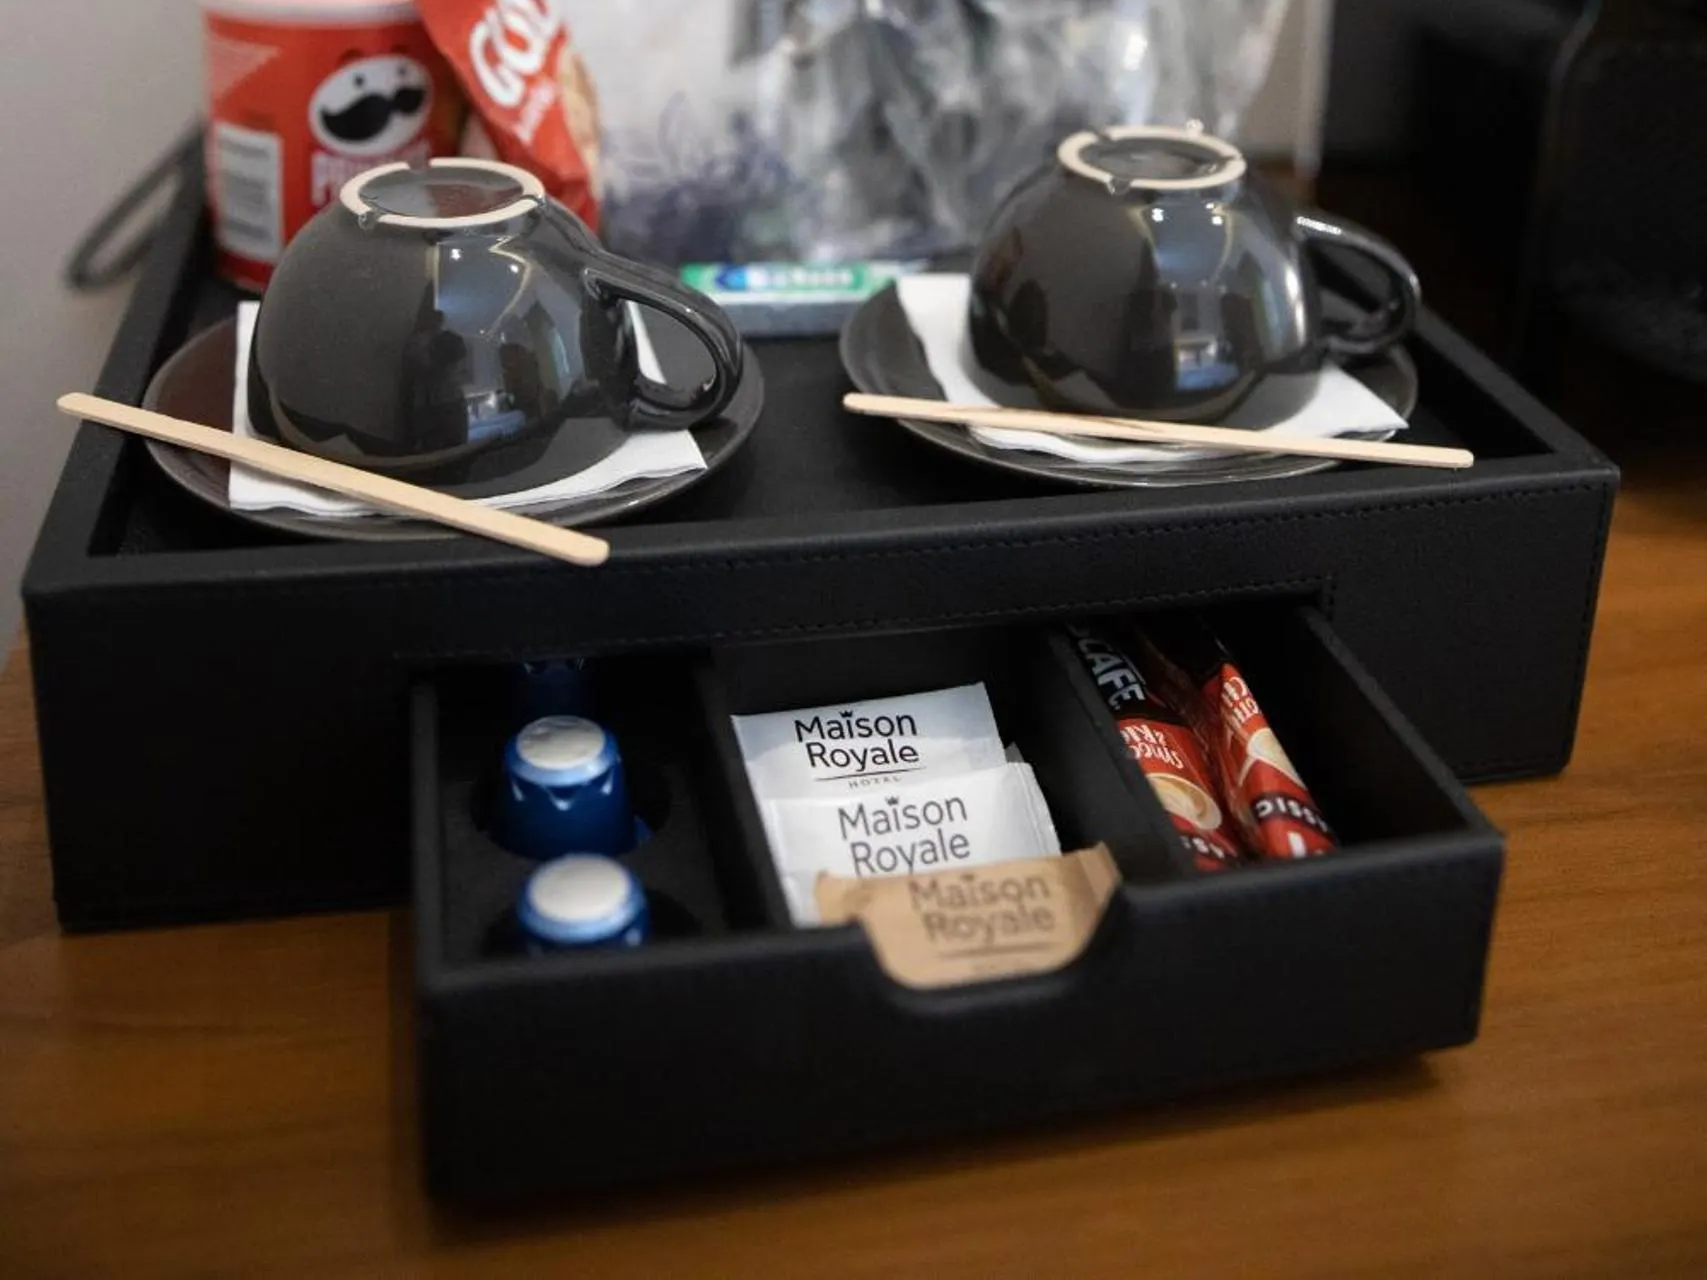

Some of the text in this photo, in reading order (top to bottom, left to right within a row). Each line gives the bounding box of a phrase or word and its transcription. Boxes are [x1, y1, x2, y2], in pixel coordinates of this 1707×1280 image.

[793, 712, 918, 743] Maison
[805, 738, 920, 772] Royale
[837, 796, 968, 841] Maison
[850, 830, 971, 877] Royale
[907, 874, 1051, 910] Maison
[920, 901, 1056, 945] Royale
